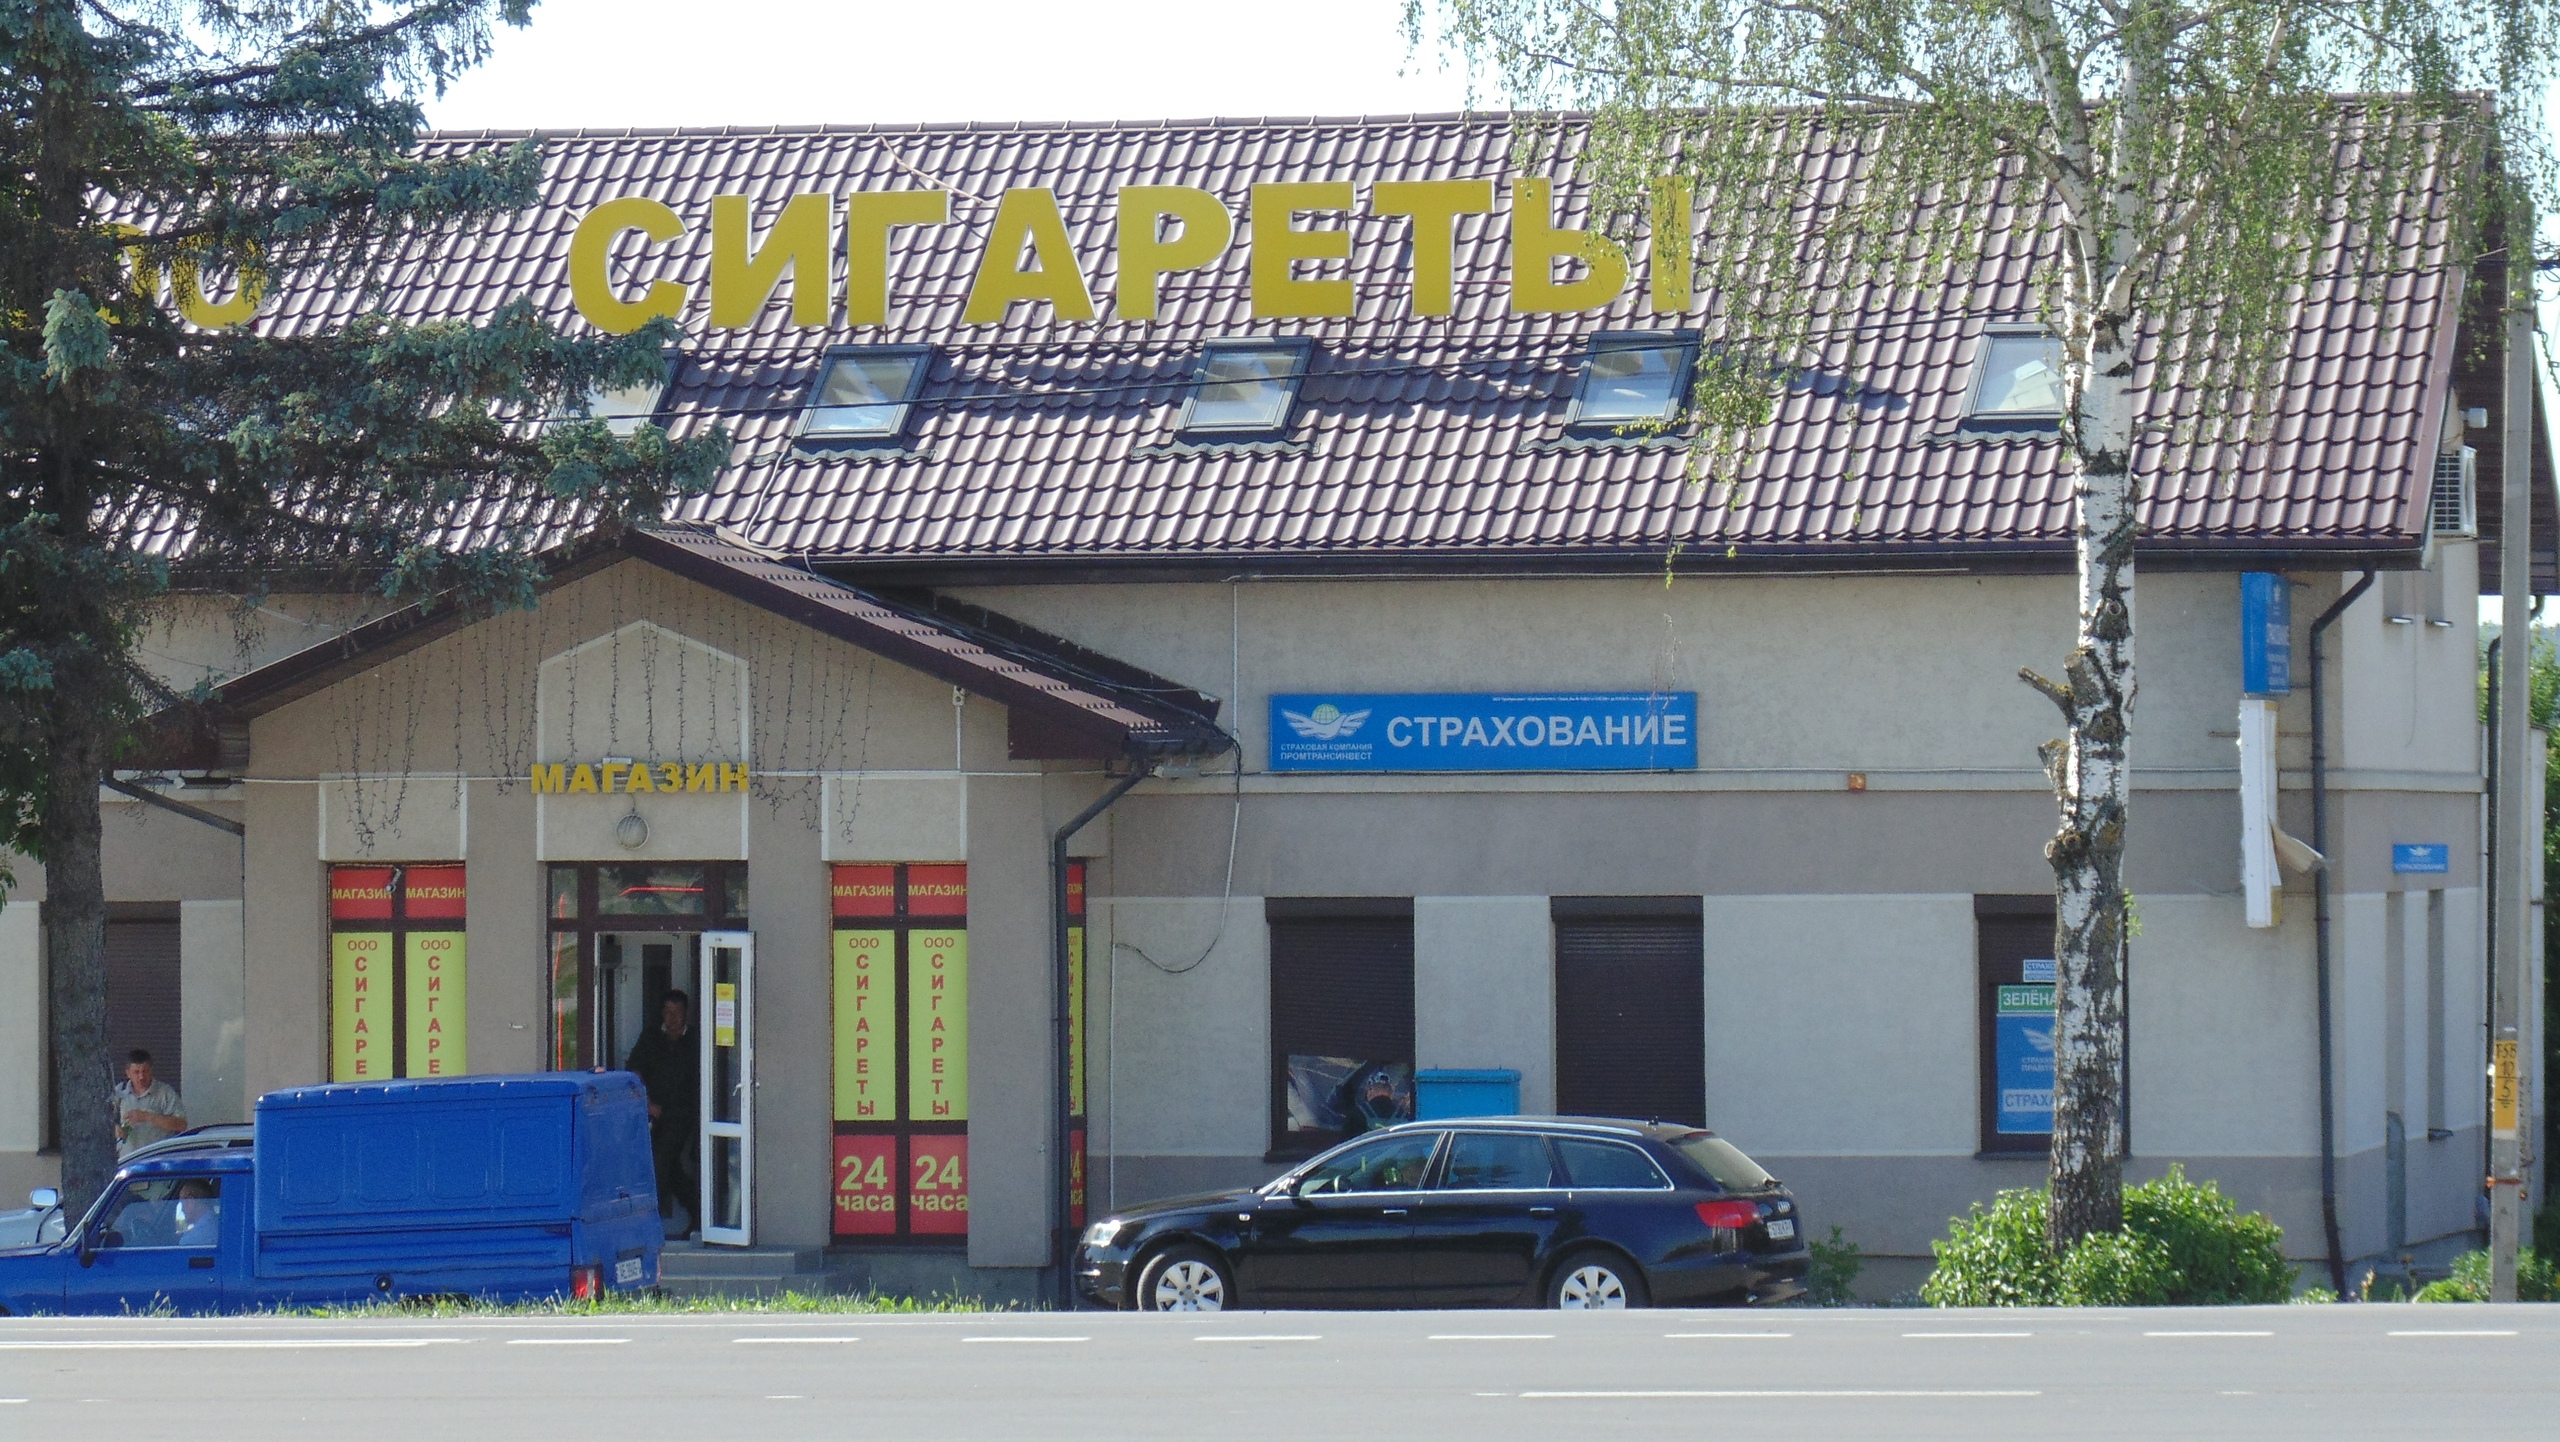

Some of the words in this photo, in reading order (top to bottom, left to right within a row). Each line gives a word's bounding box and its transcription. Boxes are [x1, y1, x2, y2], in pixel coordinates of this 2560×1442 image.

[568, 173, 1696, 335] СИГАРЕТЫ
[1387, 714, 1687, 748] СТРАХОВАНИЕ
[1281, 743, 1327, 751] СТРАХОВАЯ
[1329, 743, 1373, 751] КОМПАНИЯ
[1280, 752, 1373, 761] ПРОМТРАНСИНВЕСТ
[531, 762, 748, 794] МАГАЗИН
[333, 888, 392, 899] МАГАЗИН
[405, 887, 466, 899] МАГАЗИН
[834, 885, 894, 897] МАГАЗИН
[908, 884, 967, 896] МАГАЗИН
[347, 939, 378, 951] ООО
[420, 939, 451, 951] ООО
[849, 937, 880, 949] ООО
[924, 937, 955, 949] ООО
[855, 953, 874, 1116] СИГАРЕТЫ
[930, 953, 950, 1116] СИГАРЕТЫ
[2005, 1094, 2053, 1107] СТРАХ
[840, 1155, 888, 1190] 24
[915, 1155, 963, 1190] 24
[836, 1195, 895, 1211] часа
[910, 1195, 969, 1211] часа
